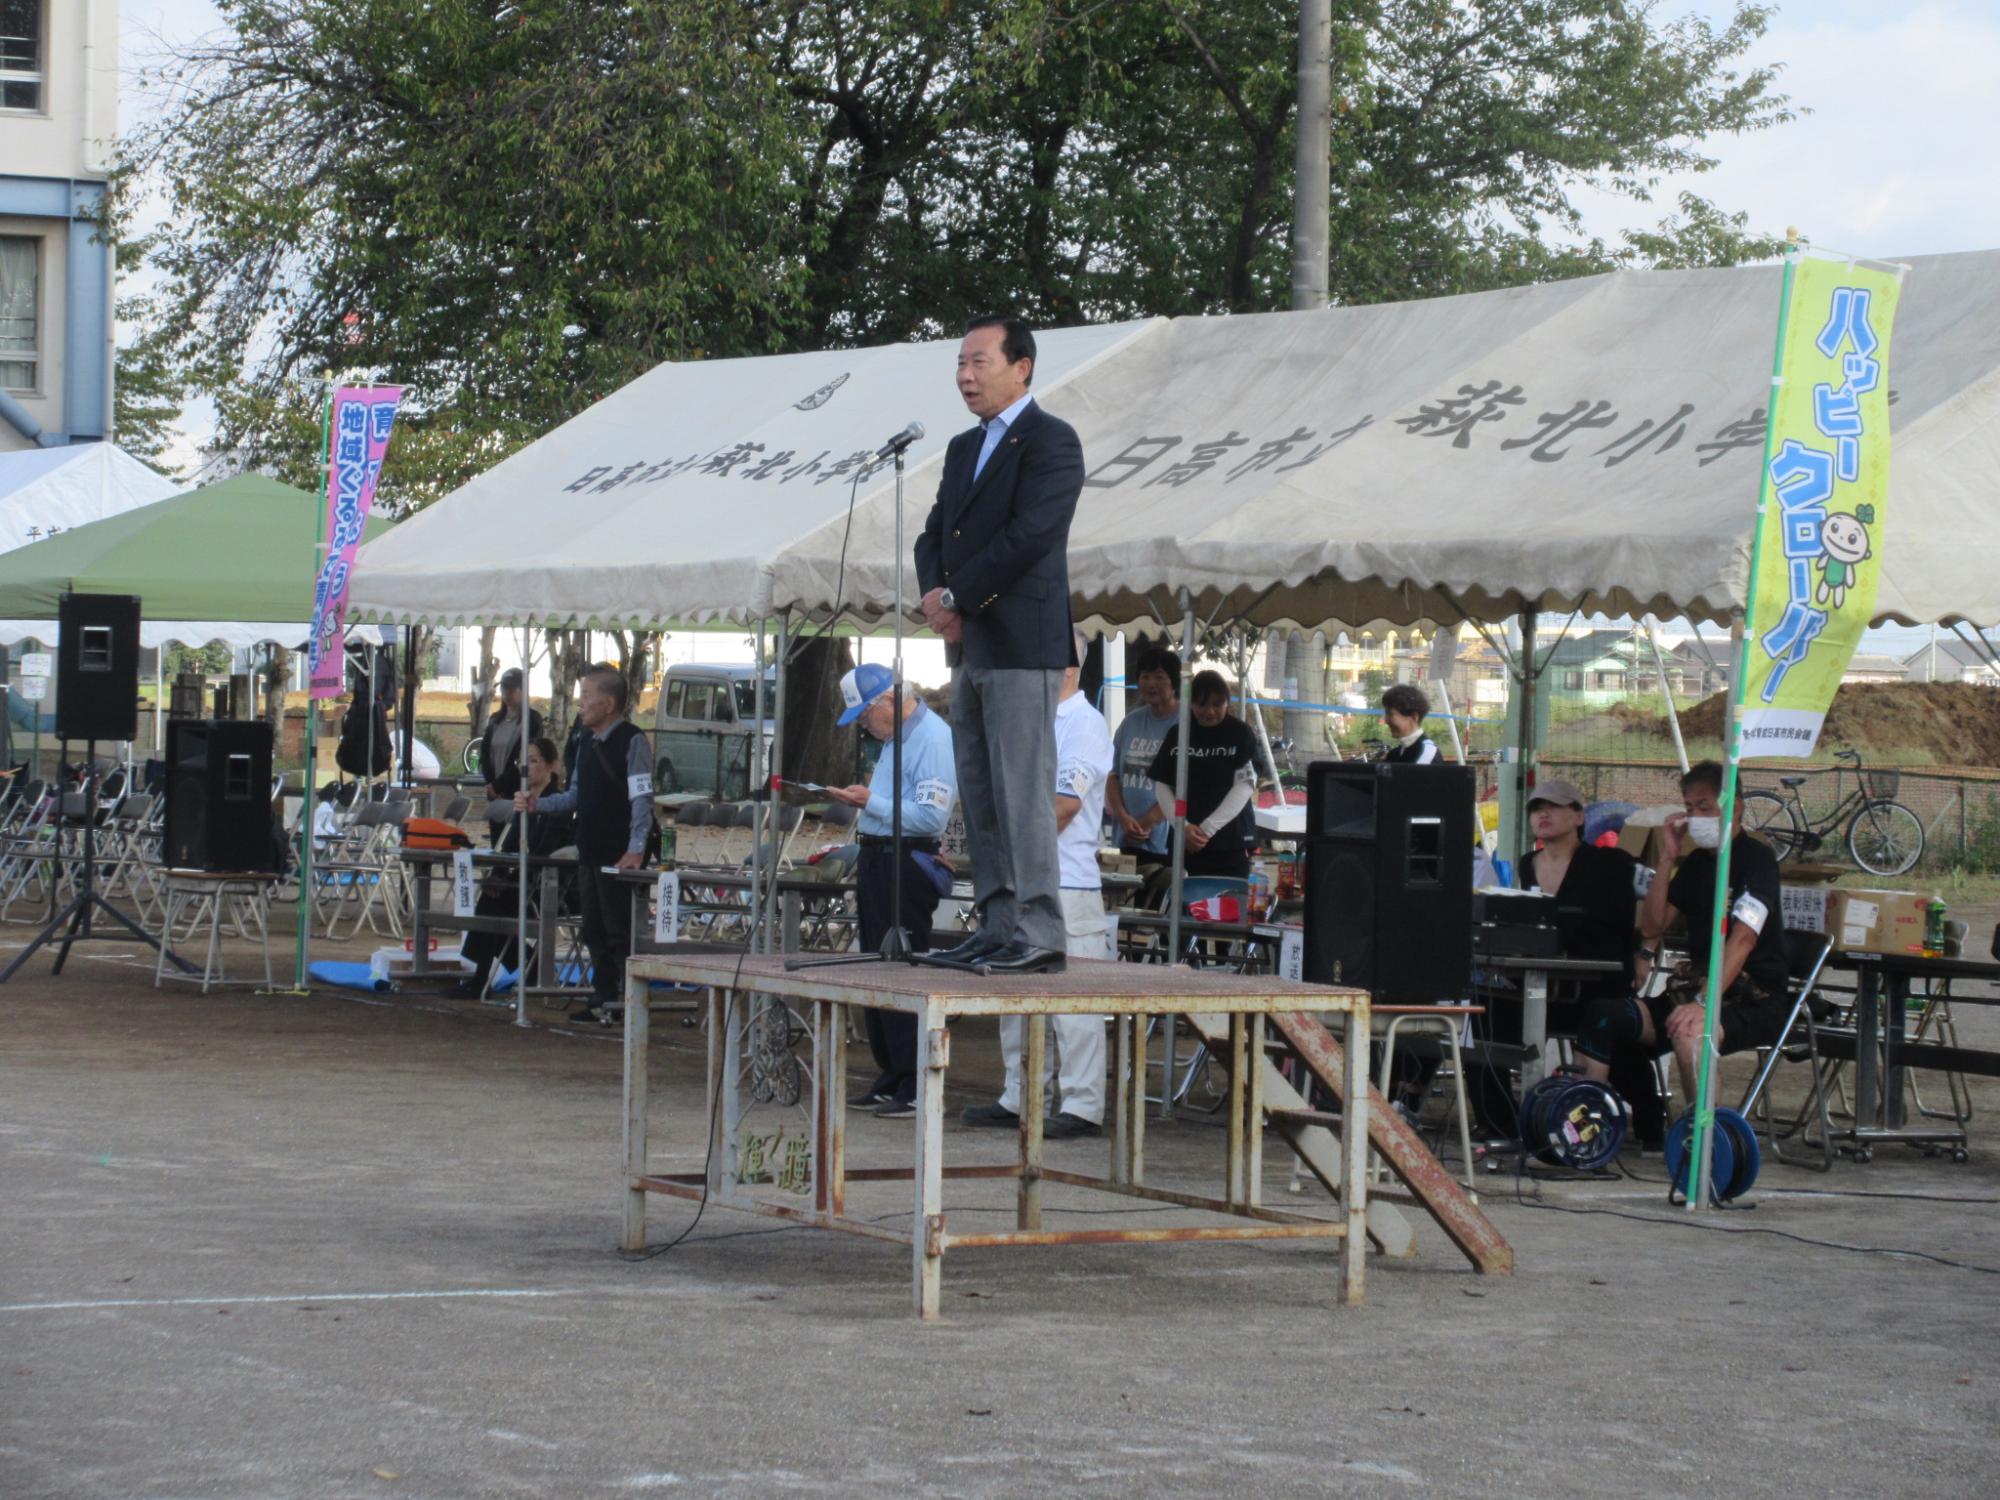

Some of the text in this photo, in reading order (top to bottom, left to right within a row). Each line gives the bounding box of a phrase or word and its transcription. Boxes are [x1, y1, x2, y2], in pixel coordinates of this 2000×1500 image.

[1815, 286, 1880, 482] ハッピー
[1760, 439, 1834, 703] クローバー
[1130, 737, 1163, 752] CRIS
[662, 882, 673, 934] 接待
